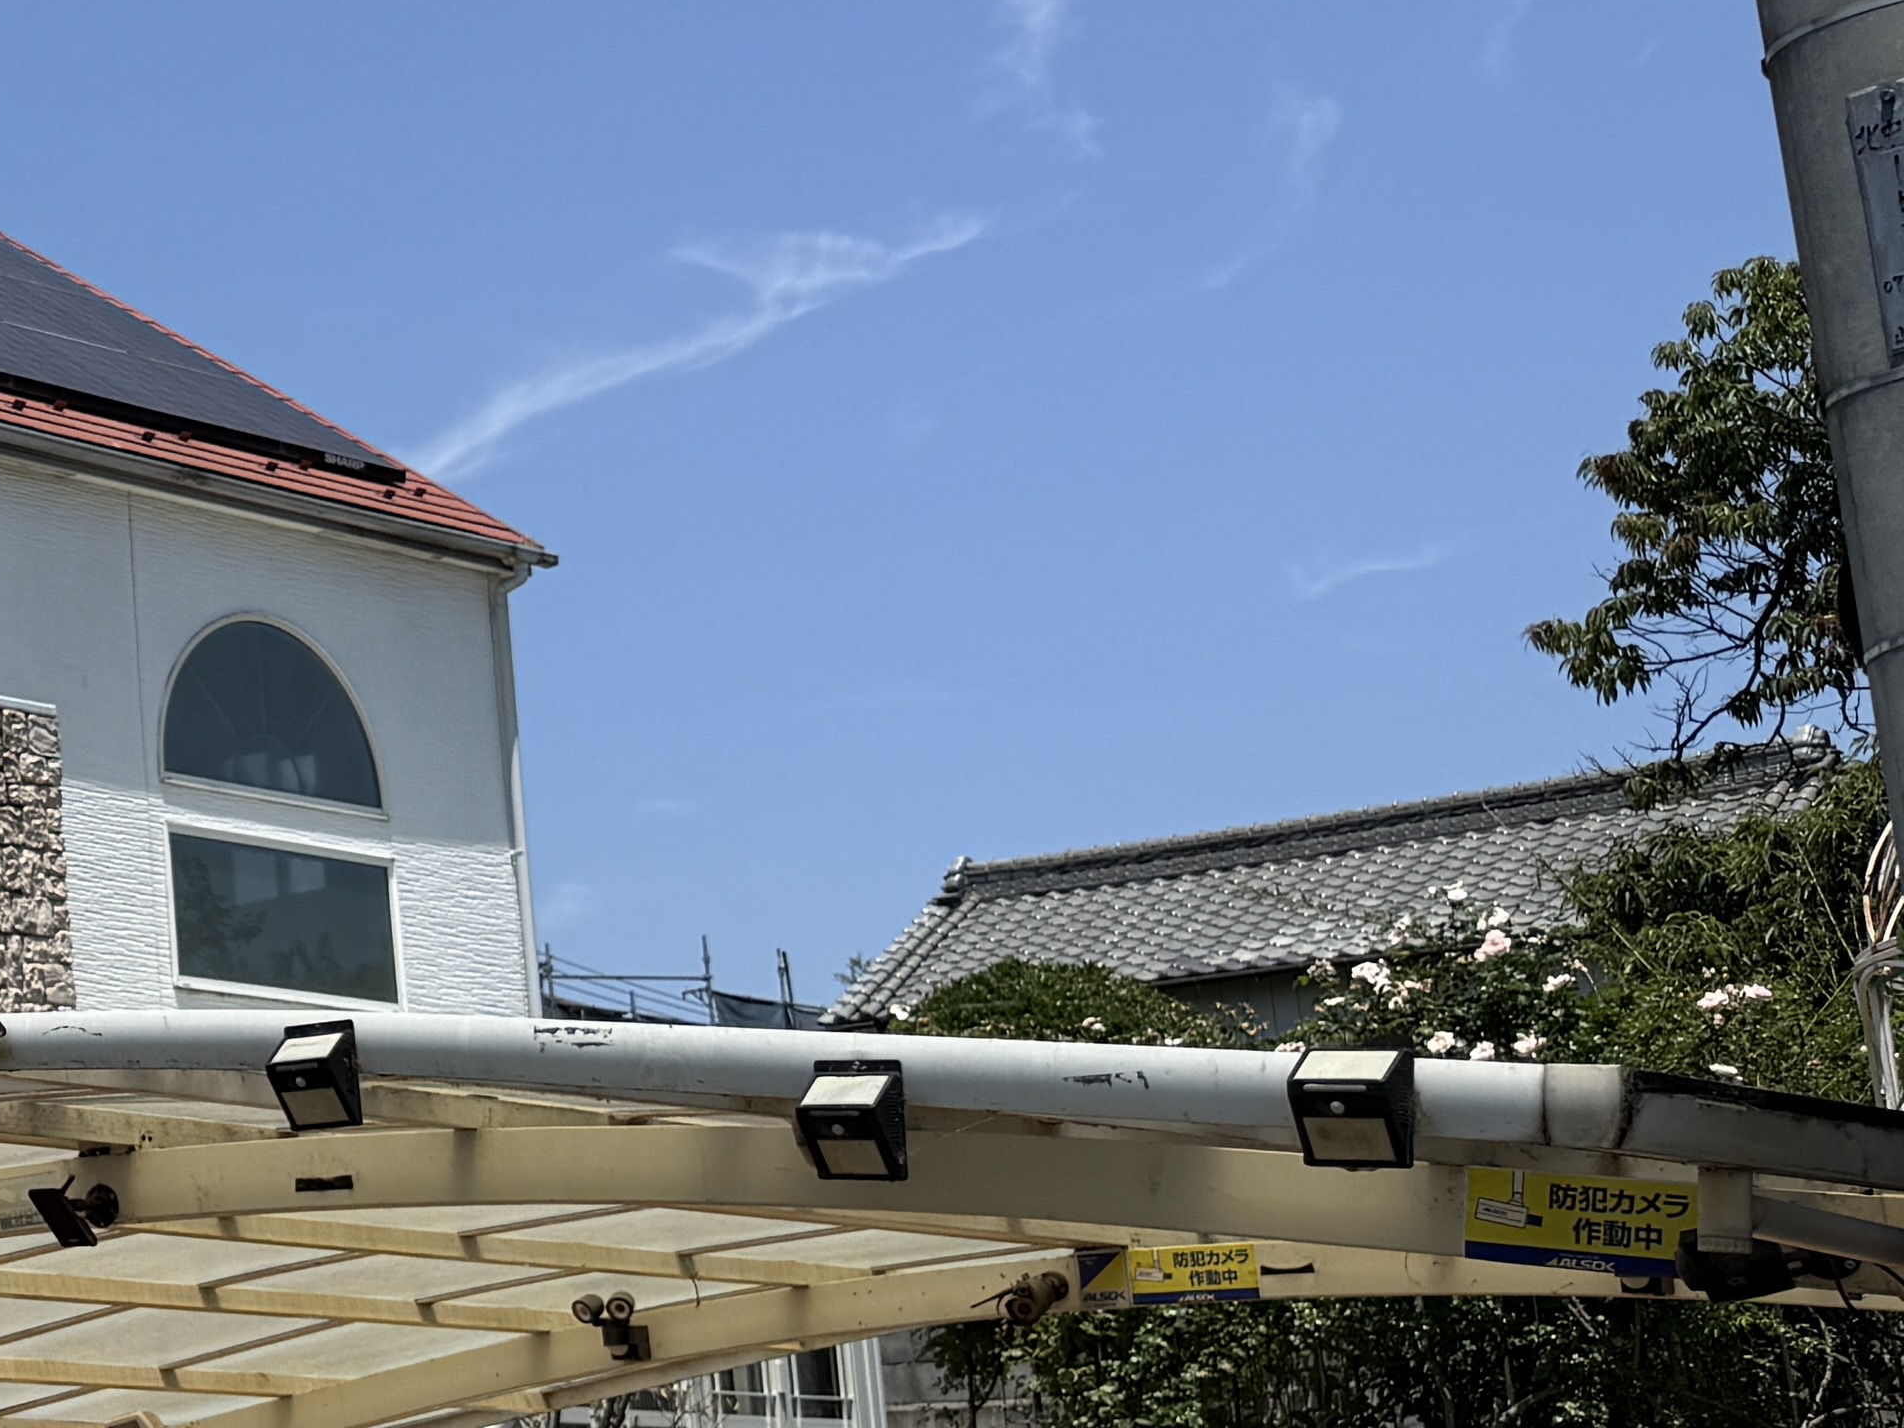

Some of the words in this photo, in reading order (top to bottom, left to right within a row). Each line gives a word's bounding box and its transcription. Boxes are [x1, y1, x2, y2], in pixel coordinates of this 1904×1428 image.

[324, 452, 366, 470] SHARP
[1549, 1182, 1690, 1219] 防犯カメラ
[1572, 1217, 1663, 1251] 作動中
[1172, 1248, 1249, 1269] 防犯カメラ
[1559, 1257, 1616, 1272] ALSOK
[1189, 1268, 1238, 1287] 作動中
